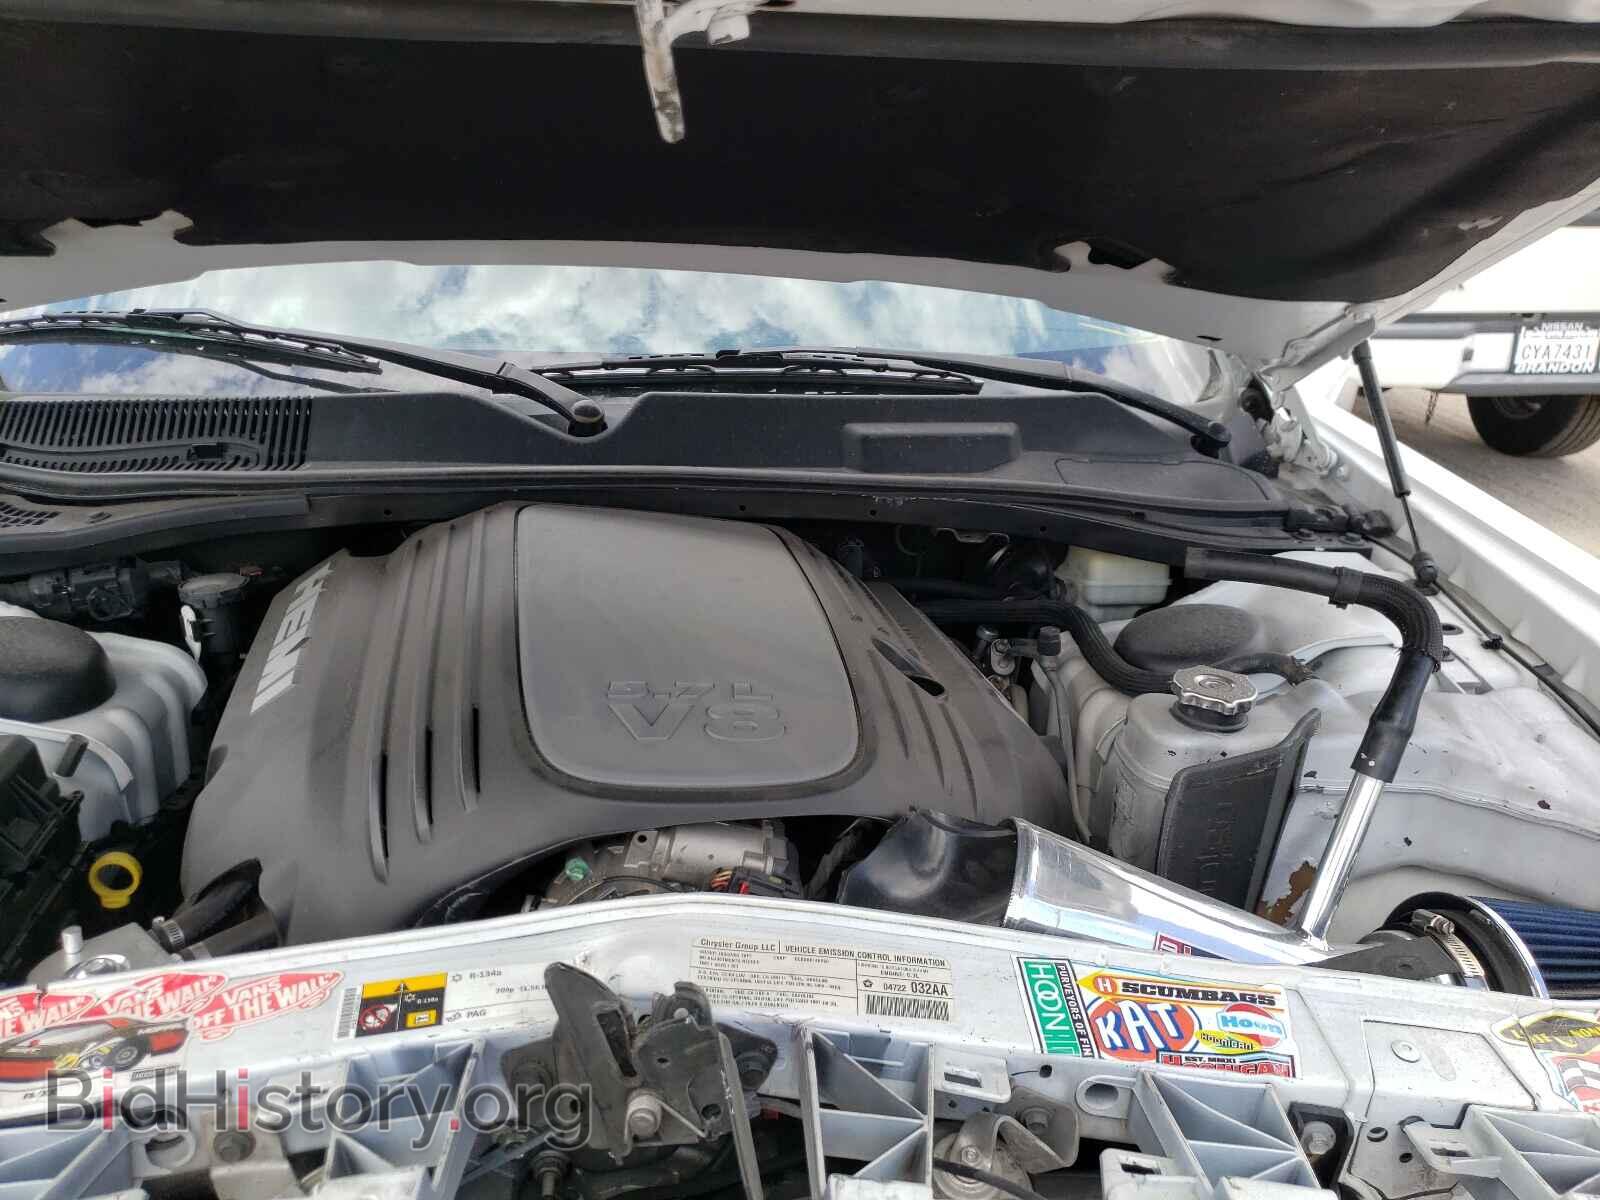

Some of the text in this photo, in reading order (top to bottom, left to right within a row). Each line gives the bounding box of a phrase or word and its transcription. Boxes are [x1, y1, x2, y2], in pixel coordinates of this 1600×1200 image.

[1521, 343, 1591, 361] CYA7431
[250, 562, 334, 713] HEMI
[607, 701, 788, 742] V8
[700, 938, 946, 967] Chrysler Group LLC VEHICLE EMISSION CONTROL INFORMATION
[222, 976, 283, 1004] VANS
[910, 981, 949, 996] 032AA
[1057, 964, 1082, 1021] PURVEYORS
[1075, 1022, 1087, 1036] OF
[1121, 981, 1276, 1006] SCUMBAGS
[231, 991, 276, 1023] THE
[1095, 999, 1185, 1054] KAT
